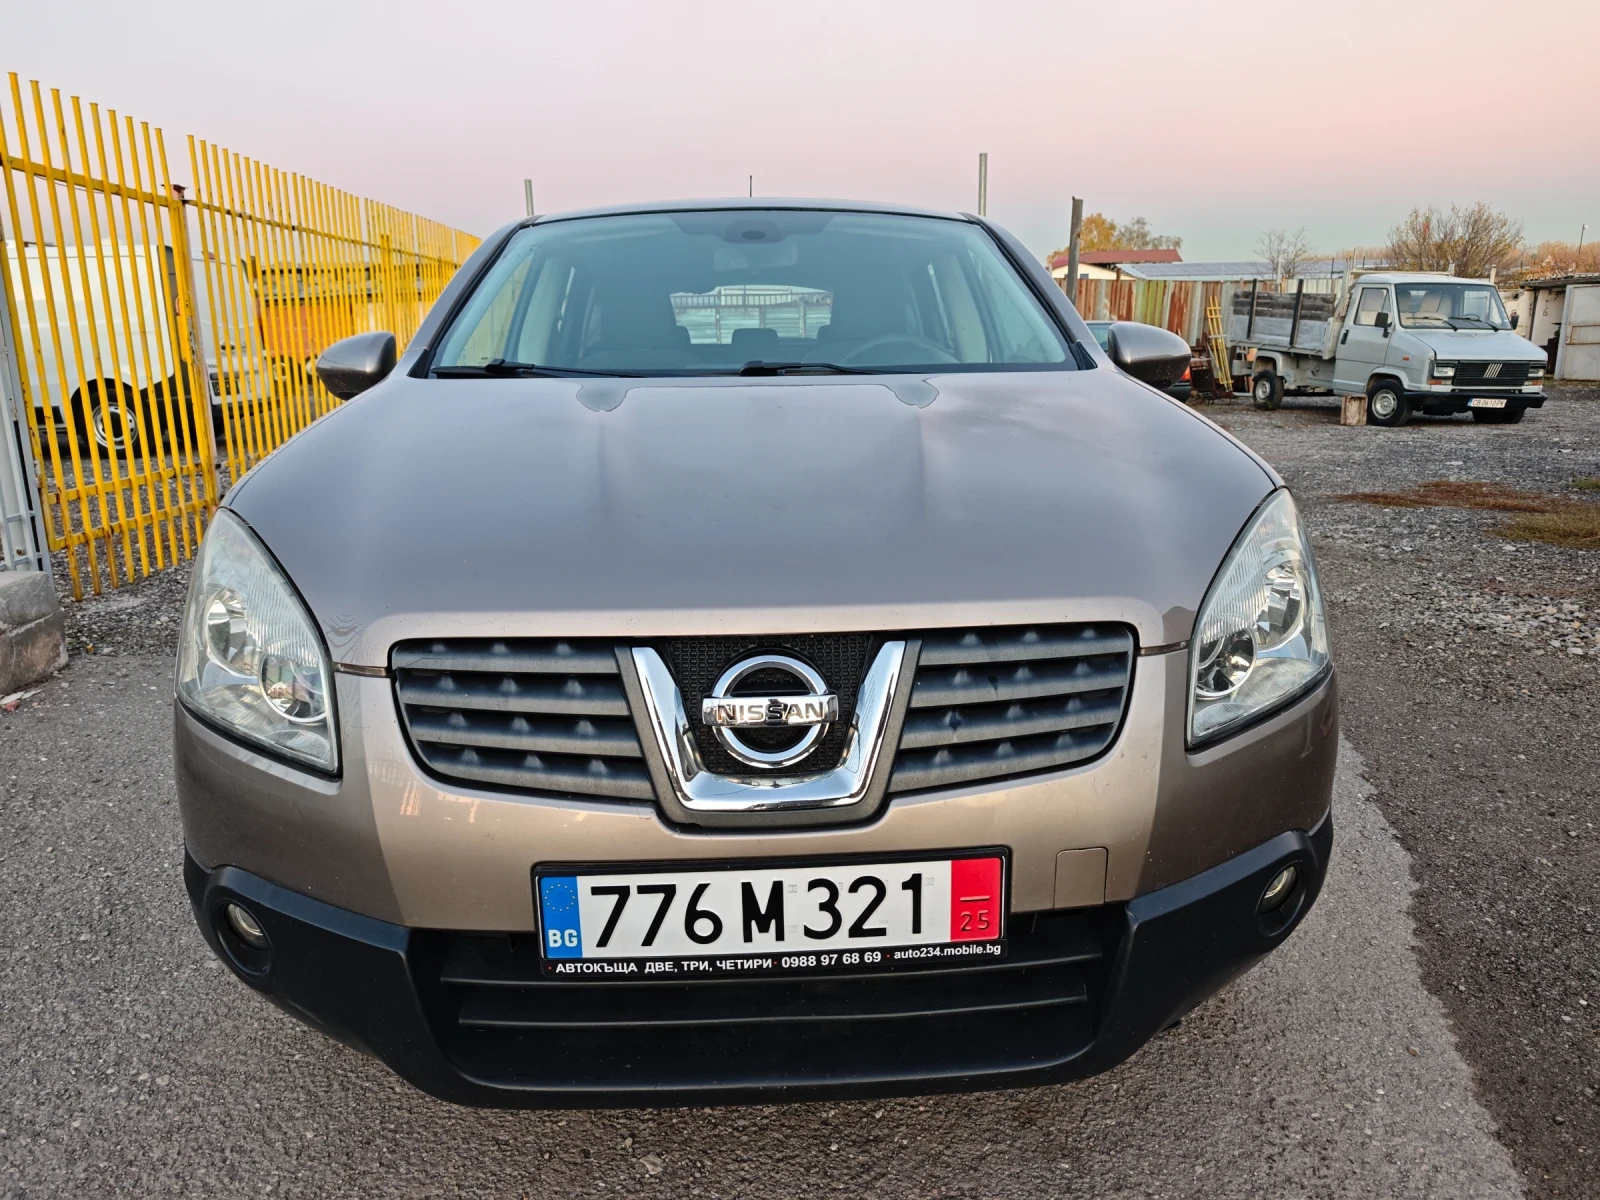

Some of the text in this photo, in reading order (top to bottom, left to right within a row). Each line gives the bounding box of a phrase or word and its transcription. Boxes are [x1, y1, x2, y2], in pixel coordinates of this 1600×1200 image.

[717, 701, 824, 721] NISSAN
[590, 872, 922, 948] 776 M 321
[960, 909, 990, 932] 25
[547, 928, 578, 948] BG
[555, 944, 1001, 974] АВТОКЪЩА ДВЕ, ТРИ, ЧЕТИРИ 0988 97 68 69 auto234.mobile.bg
